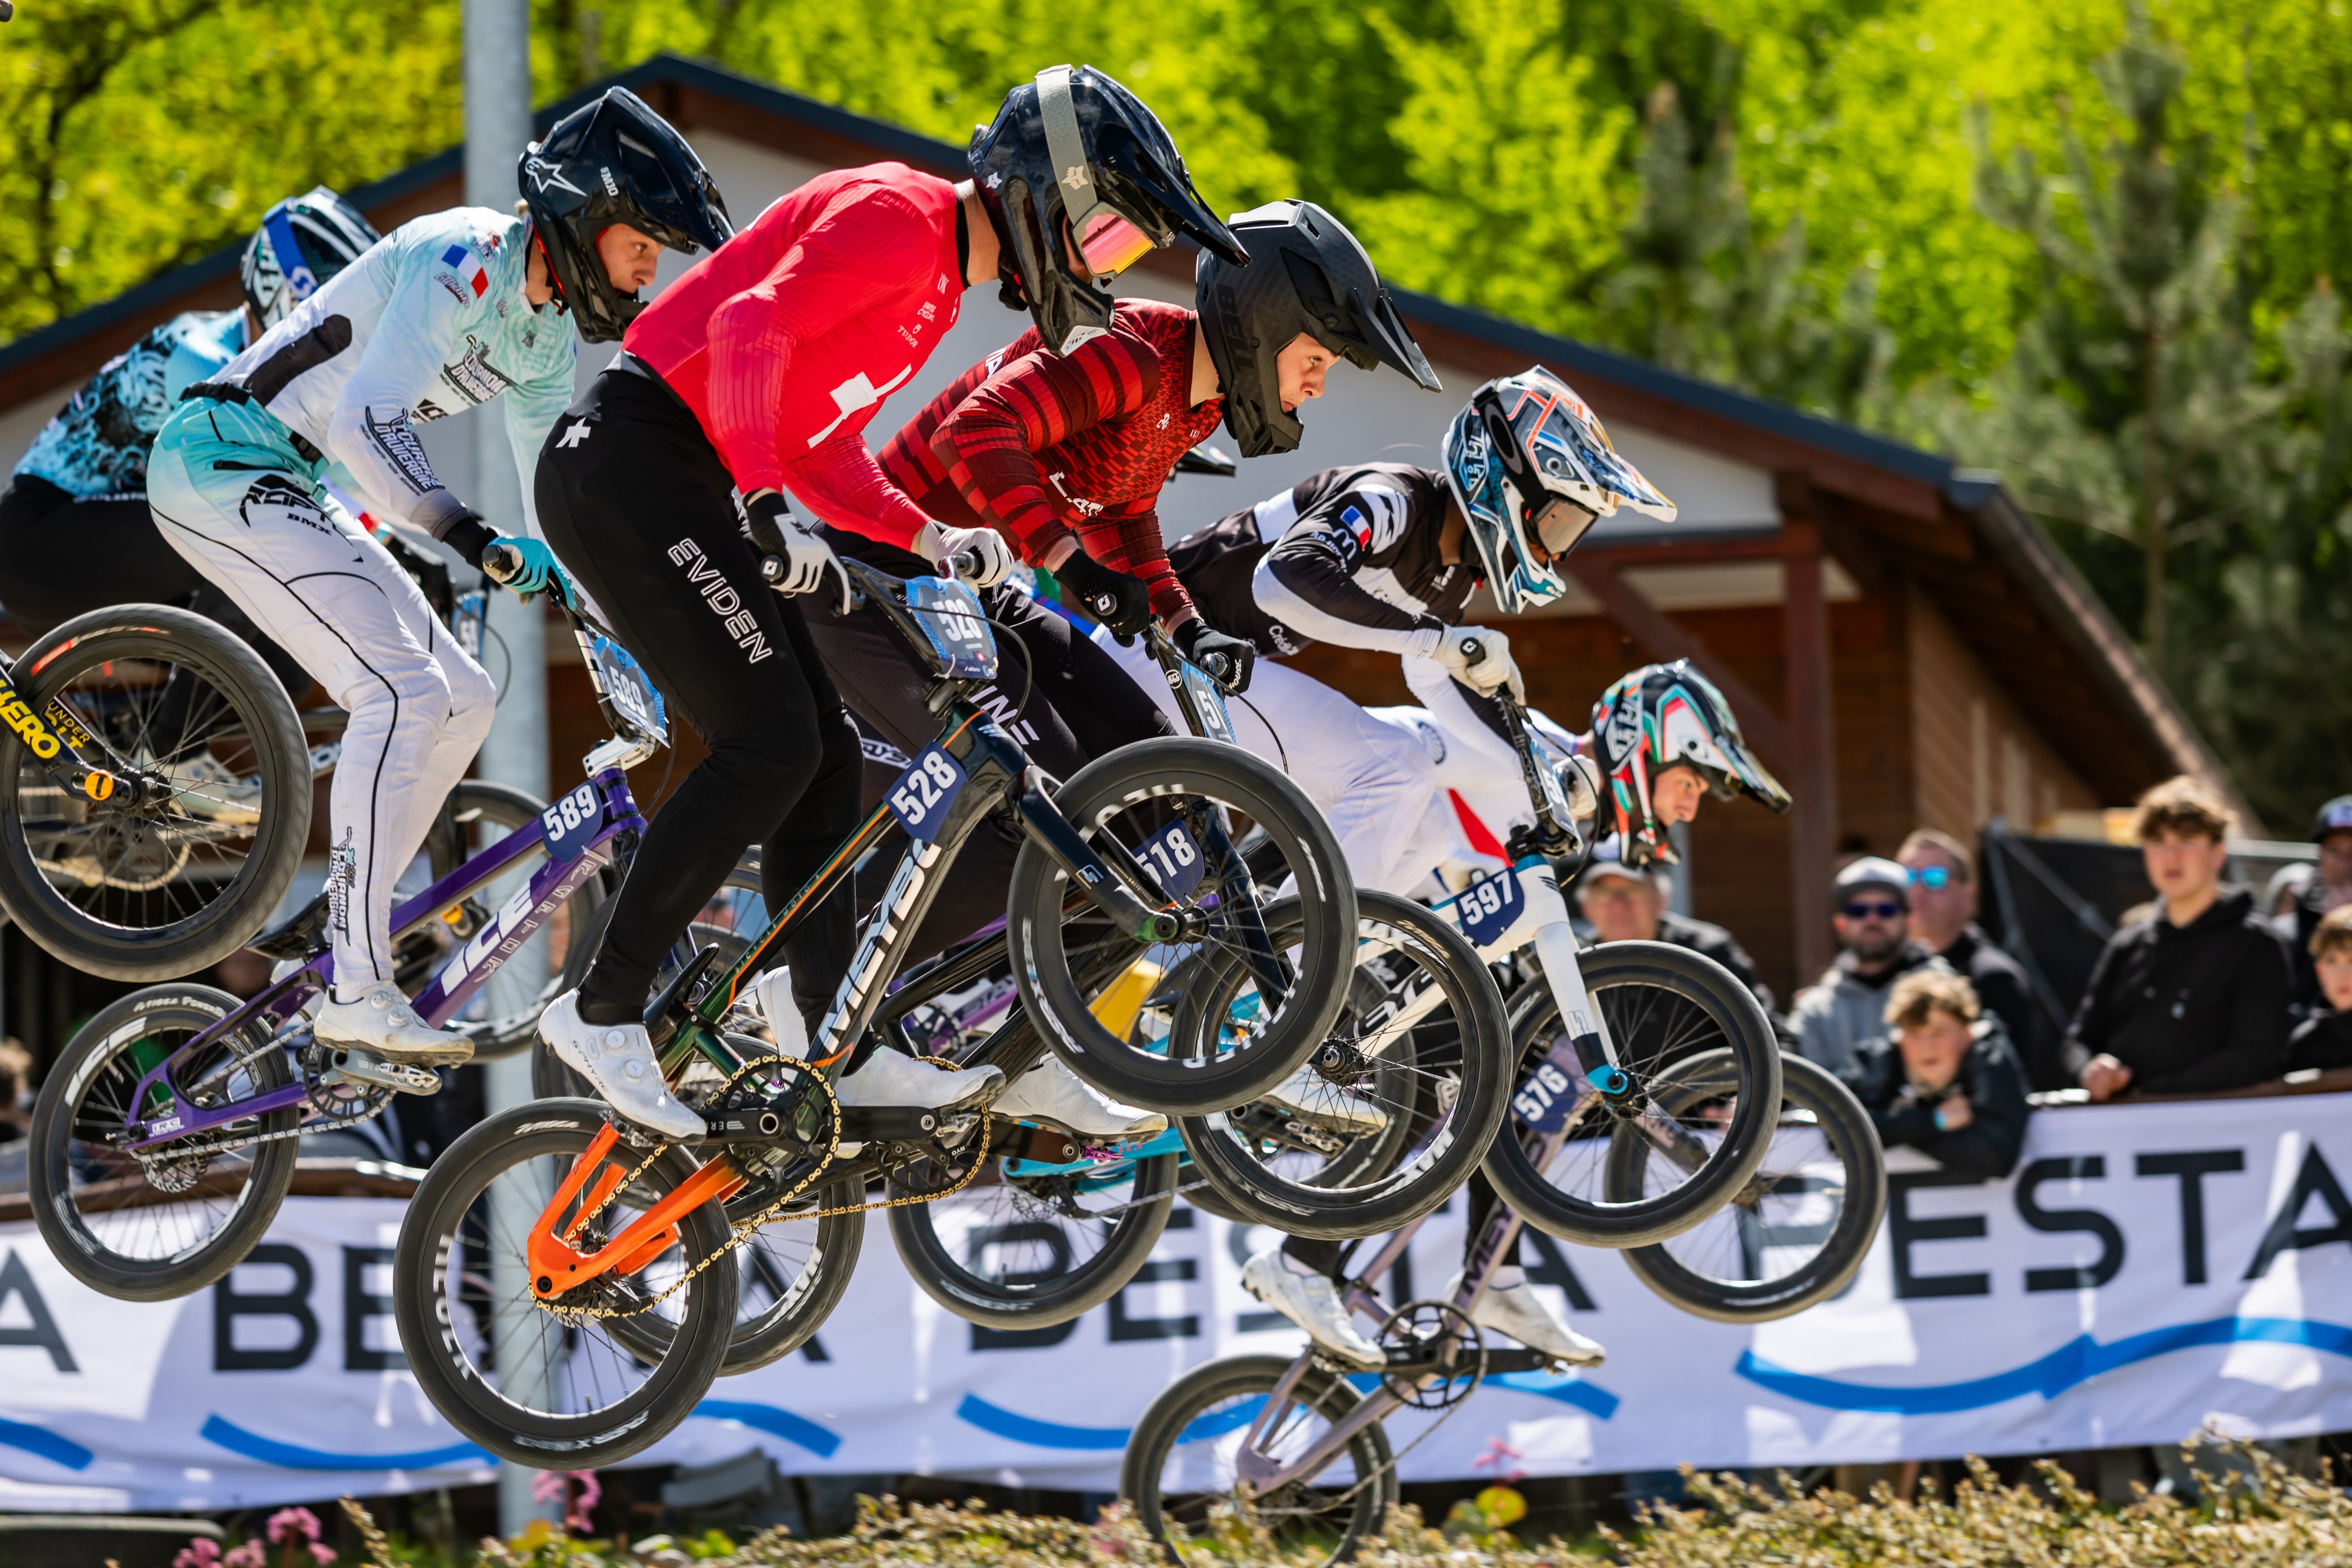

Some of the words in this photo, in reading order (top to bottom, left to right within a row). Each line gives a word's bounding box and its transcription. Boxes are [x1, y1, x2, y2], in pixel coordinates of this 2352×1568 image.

[922, 301, 936, 313] SWISS
[897, 325, 918, 348] TUDOR
[287, 512, 332, 537] BMX
[668, 538, 773, 664] EVIDEN
[931, 599, 983, 642] 528
[609, 665, 648, 718] 589
[48, 702, 90, 743] UNDER
[542, 784, 597, 841] 589
[890, 751, 957, 825] 528
[1135, 827, 1196, 886] 518
[474, 859, 597, 983] RAPTOR
[1459, 871, 1513, 925] 597
[441, 879, 534, 996] ICE
[734, 921, 777, 974] BICYCLE
[783, 885, 810, 917] MOTO
[1514, 1063, 1569, 1122] 576
